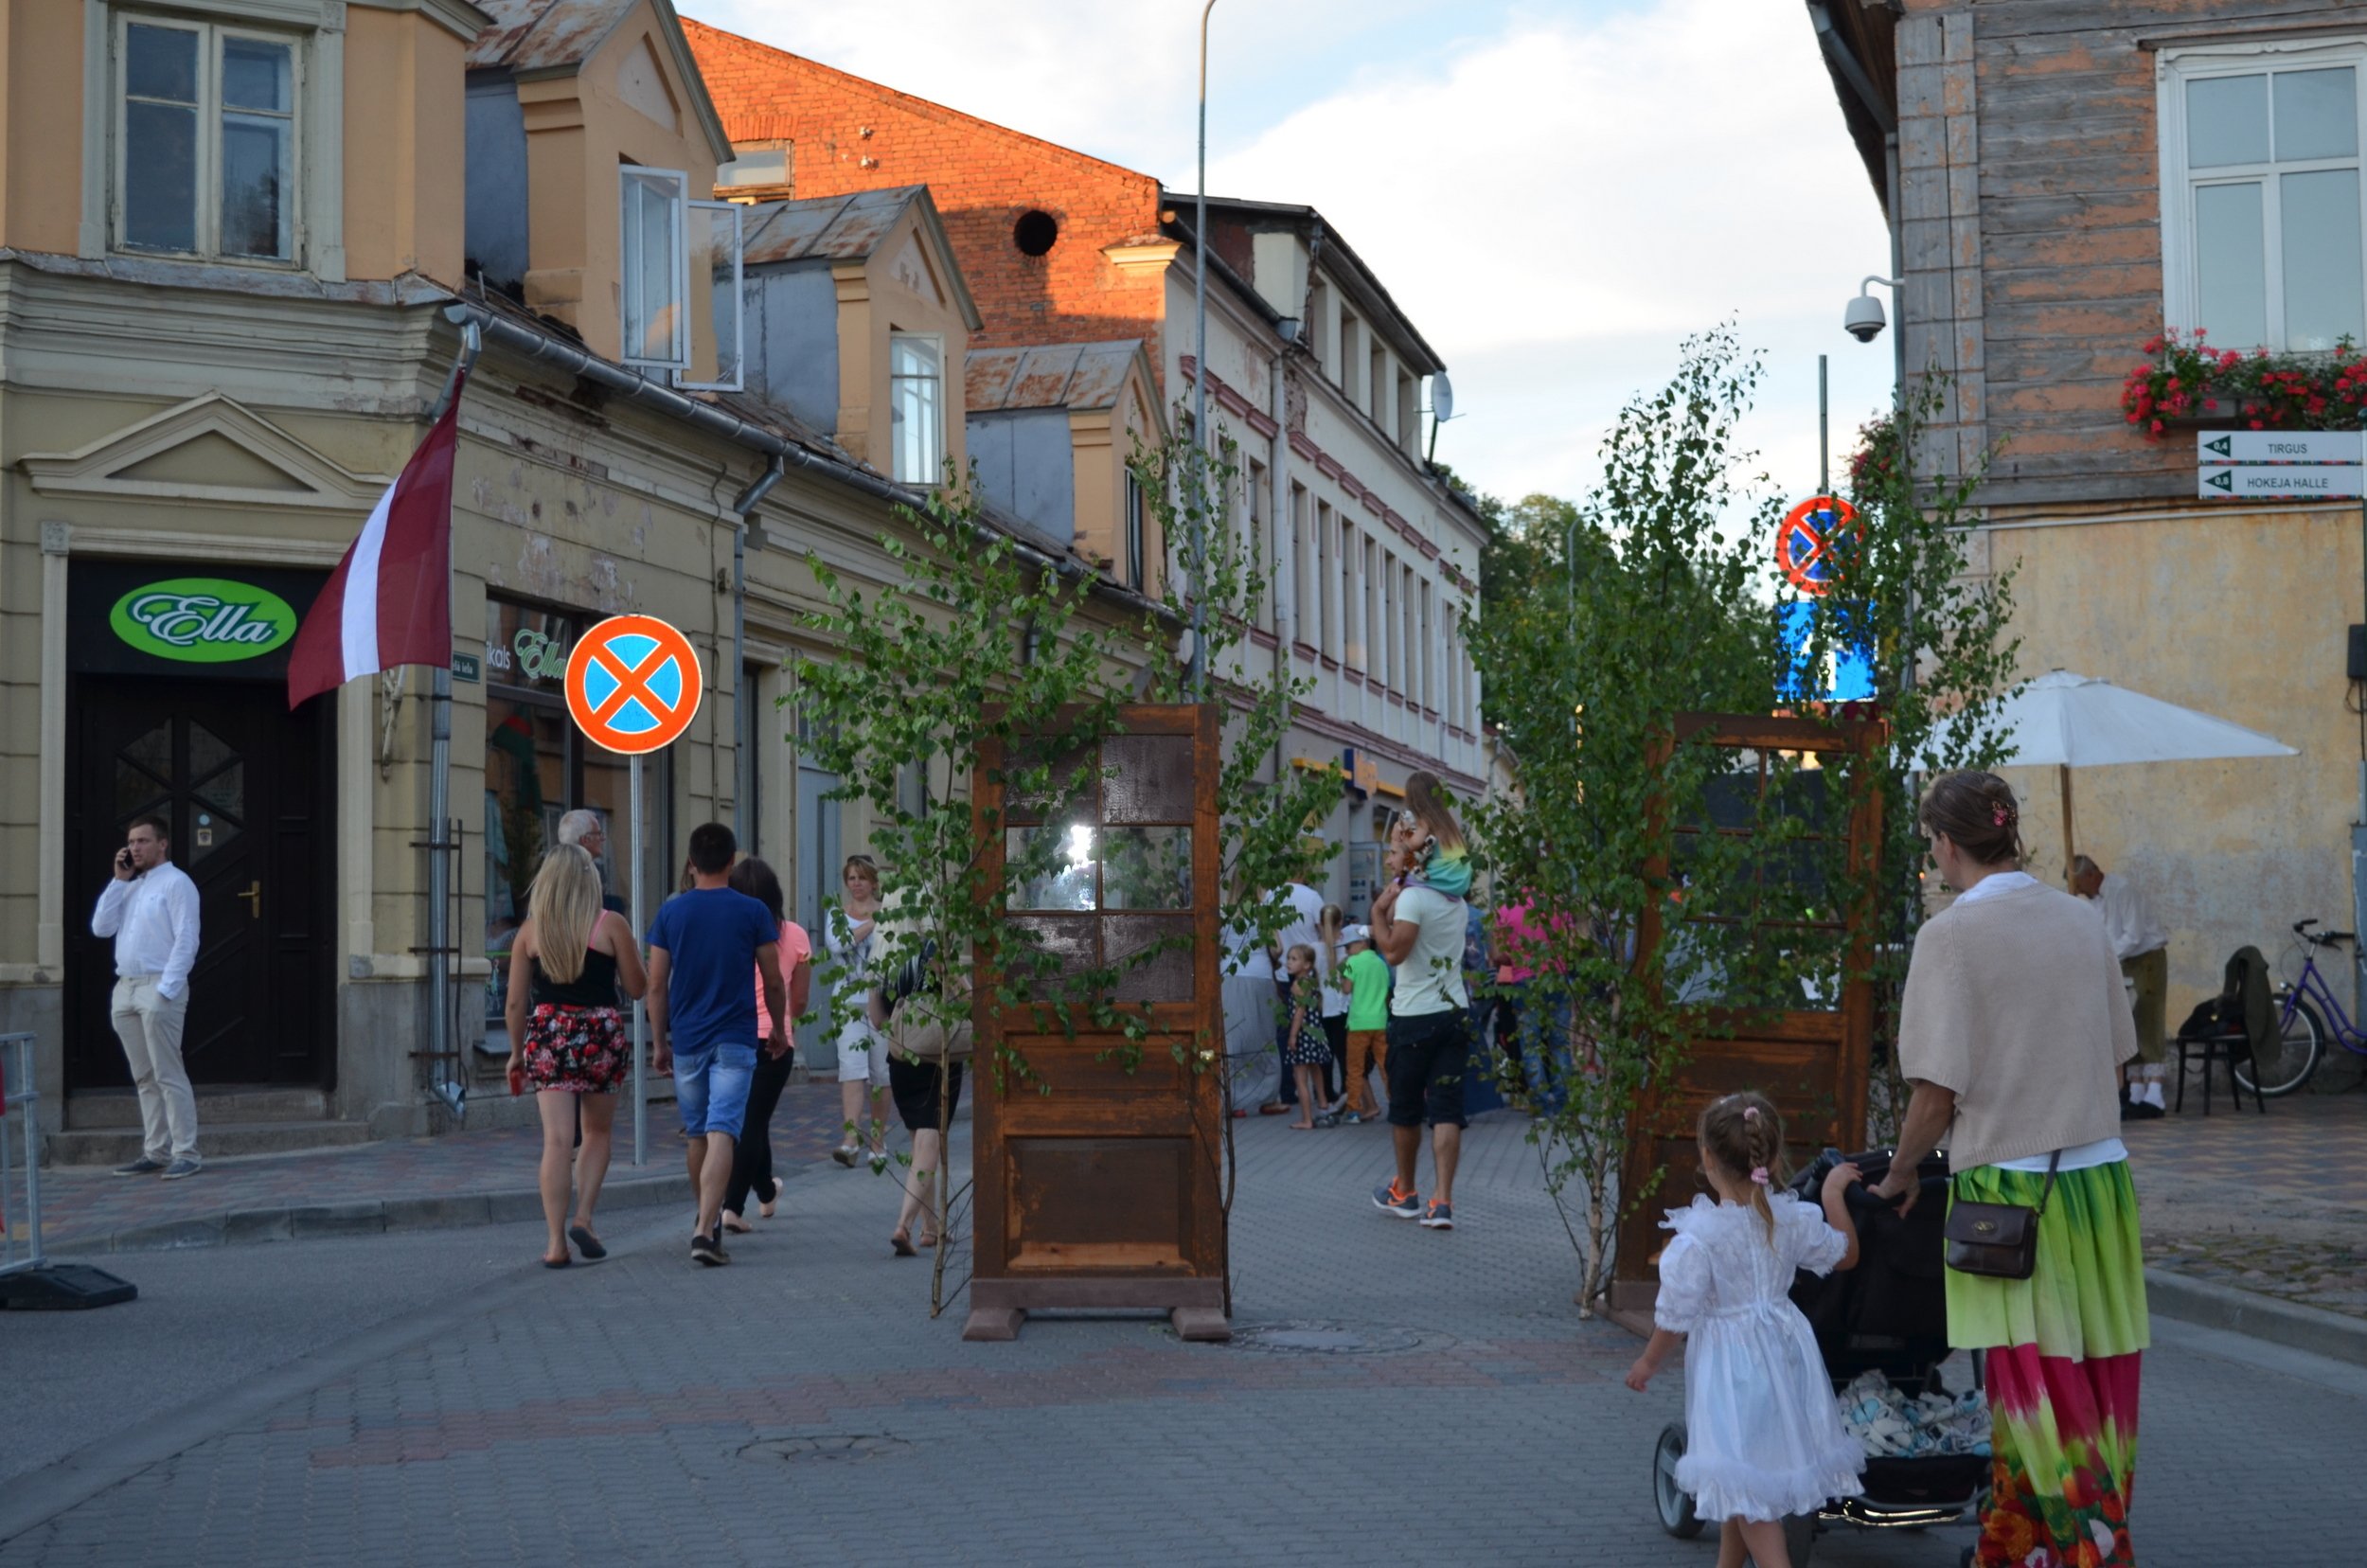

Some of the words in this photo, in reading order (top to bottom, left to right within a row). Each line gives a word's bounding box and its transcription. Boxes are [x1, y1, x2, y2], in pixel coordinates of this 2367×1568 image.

[2214, 441, 2229, 452] 0,4
[2268, 444, 2308, 454] TIRGUS
[2247, 478, 2291, 488] HOKEJA
[2293, 478, 2328, 489] HALLE
[131, 594, 275, 646] Ella
[514, 629, 567, 679] Ella
